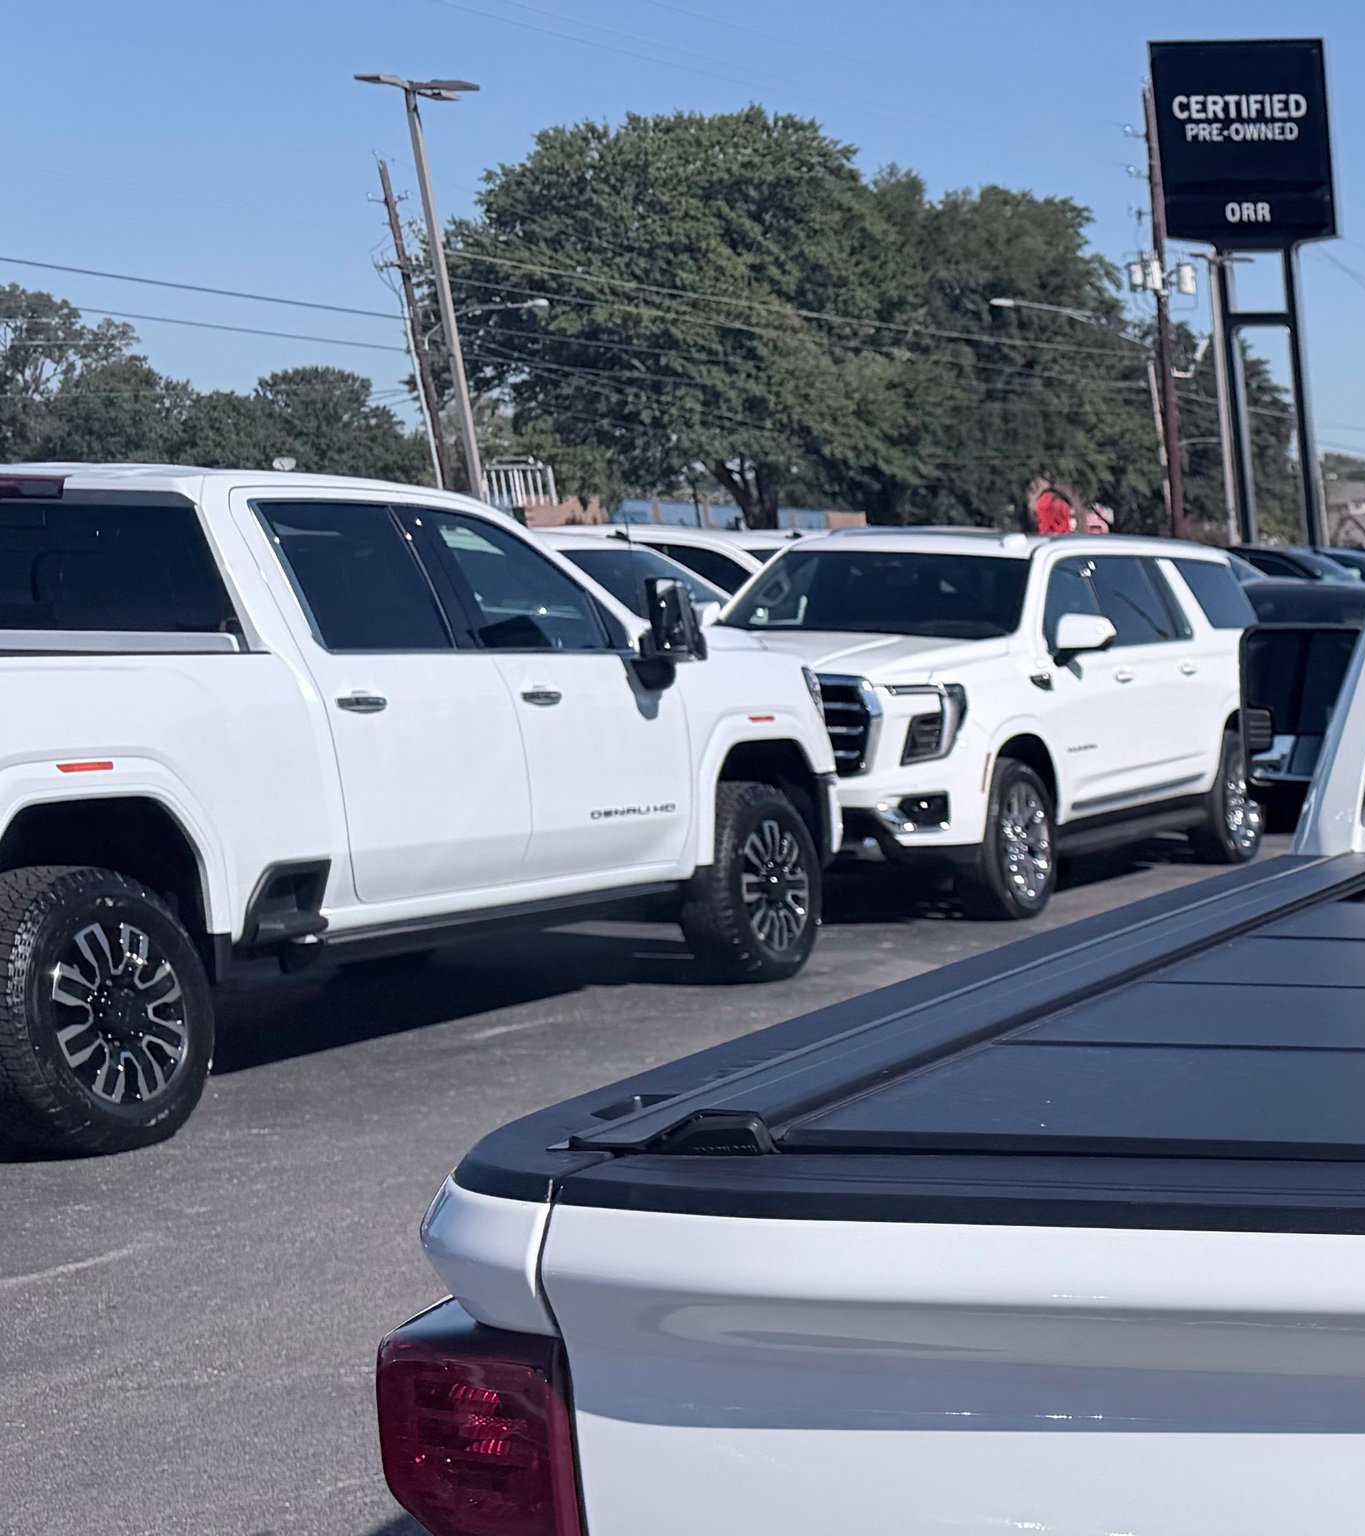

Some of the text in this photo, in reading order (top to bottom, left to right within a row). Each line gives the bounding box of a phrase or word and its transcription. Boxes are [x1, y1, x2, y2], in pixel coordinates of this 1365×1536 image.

[1172, 93, 1308, 120] CERTIFIED
[1185, 122, 1299, 142] PRE-OWNED
[1225, 201, 1271, 223] ORR
